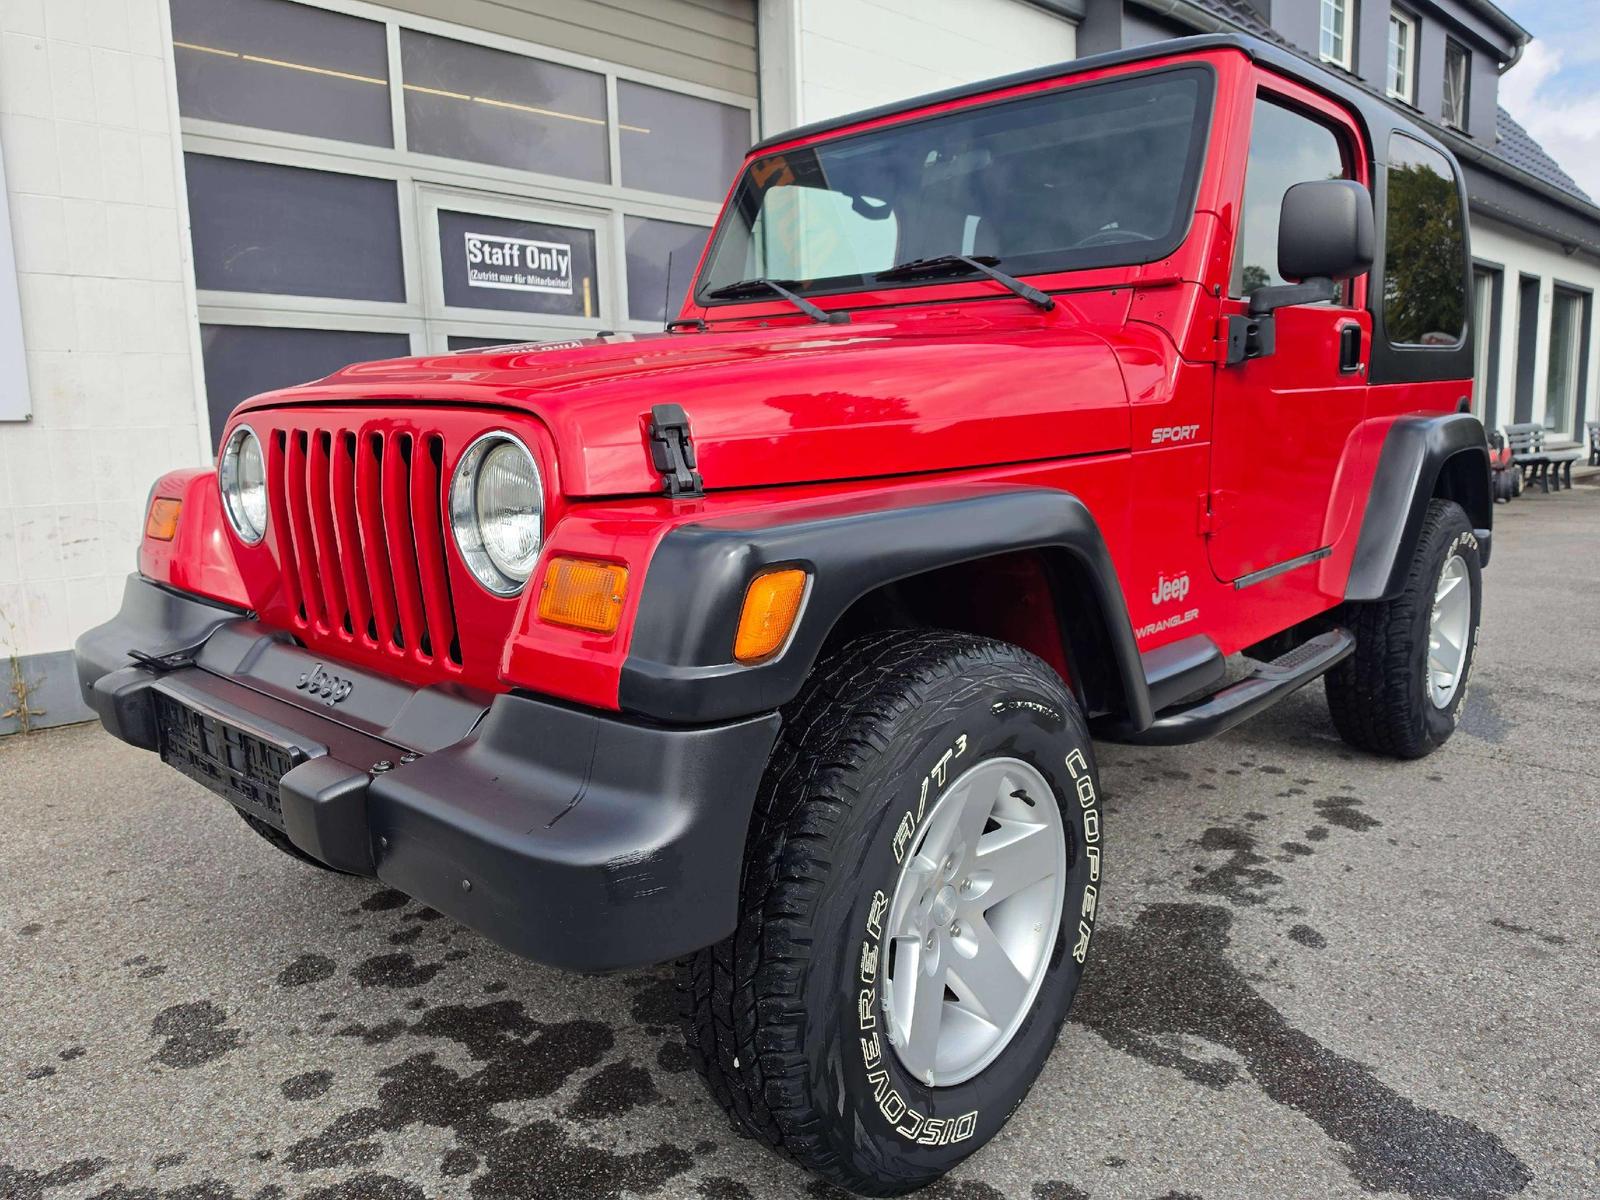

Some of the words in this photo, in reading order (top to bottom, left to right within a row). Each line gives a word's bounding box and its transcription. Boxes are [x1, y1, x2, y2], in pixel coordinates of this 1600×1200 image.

[469, 239, 520, 267] Staff
[526, 246, 569, 277] Only
[470, 269, 499, 281] (Zutritt
[499, 274, 513, 283] nur
[514, 273, 526, 284] für
[1151, 424, 1200, 444] SPORT
[1151, 575, 1190, 605] Jeep
[1135, 608, 1200, 640] WRANGLER
[296, 662, 354, 708] Jeep
[1065, 748, 1100, 963] COOPER
[858, 889, 978, 1146] DISCOVERER
